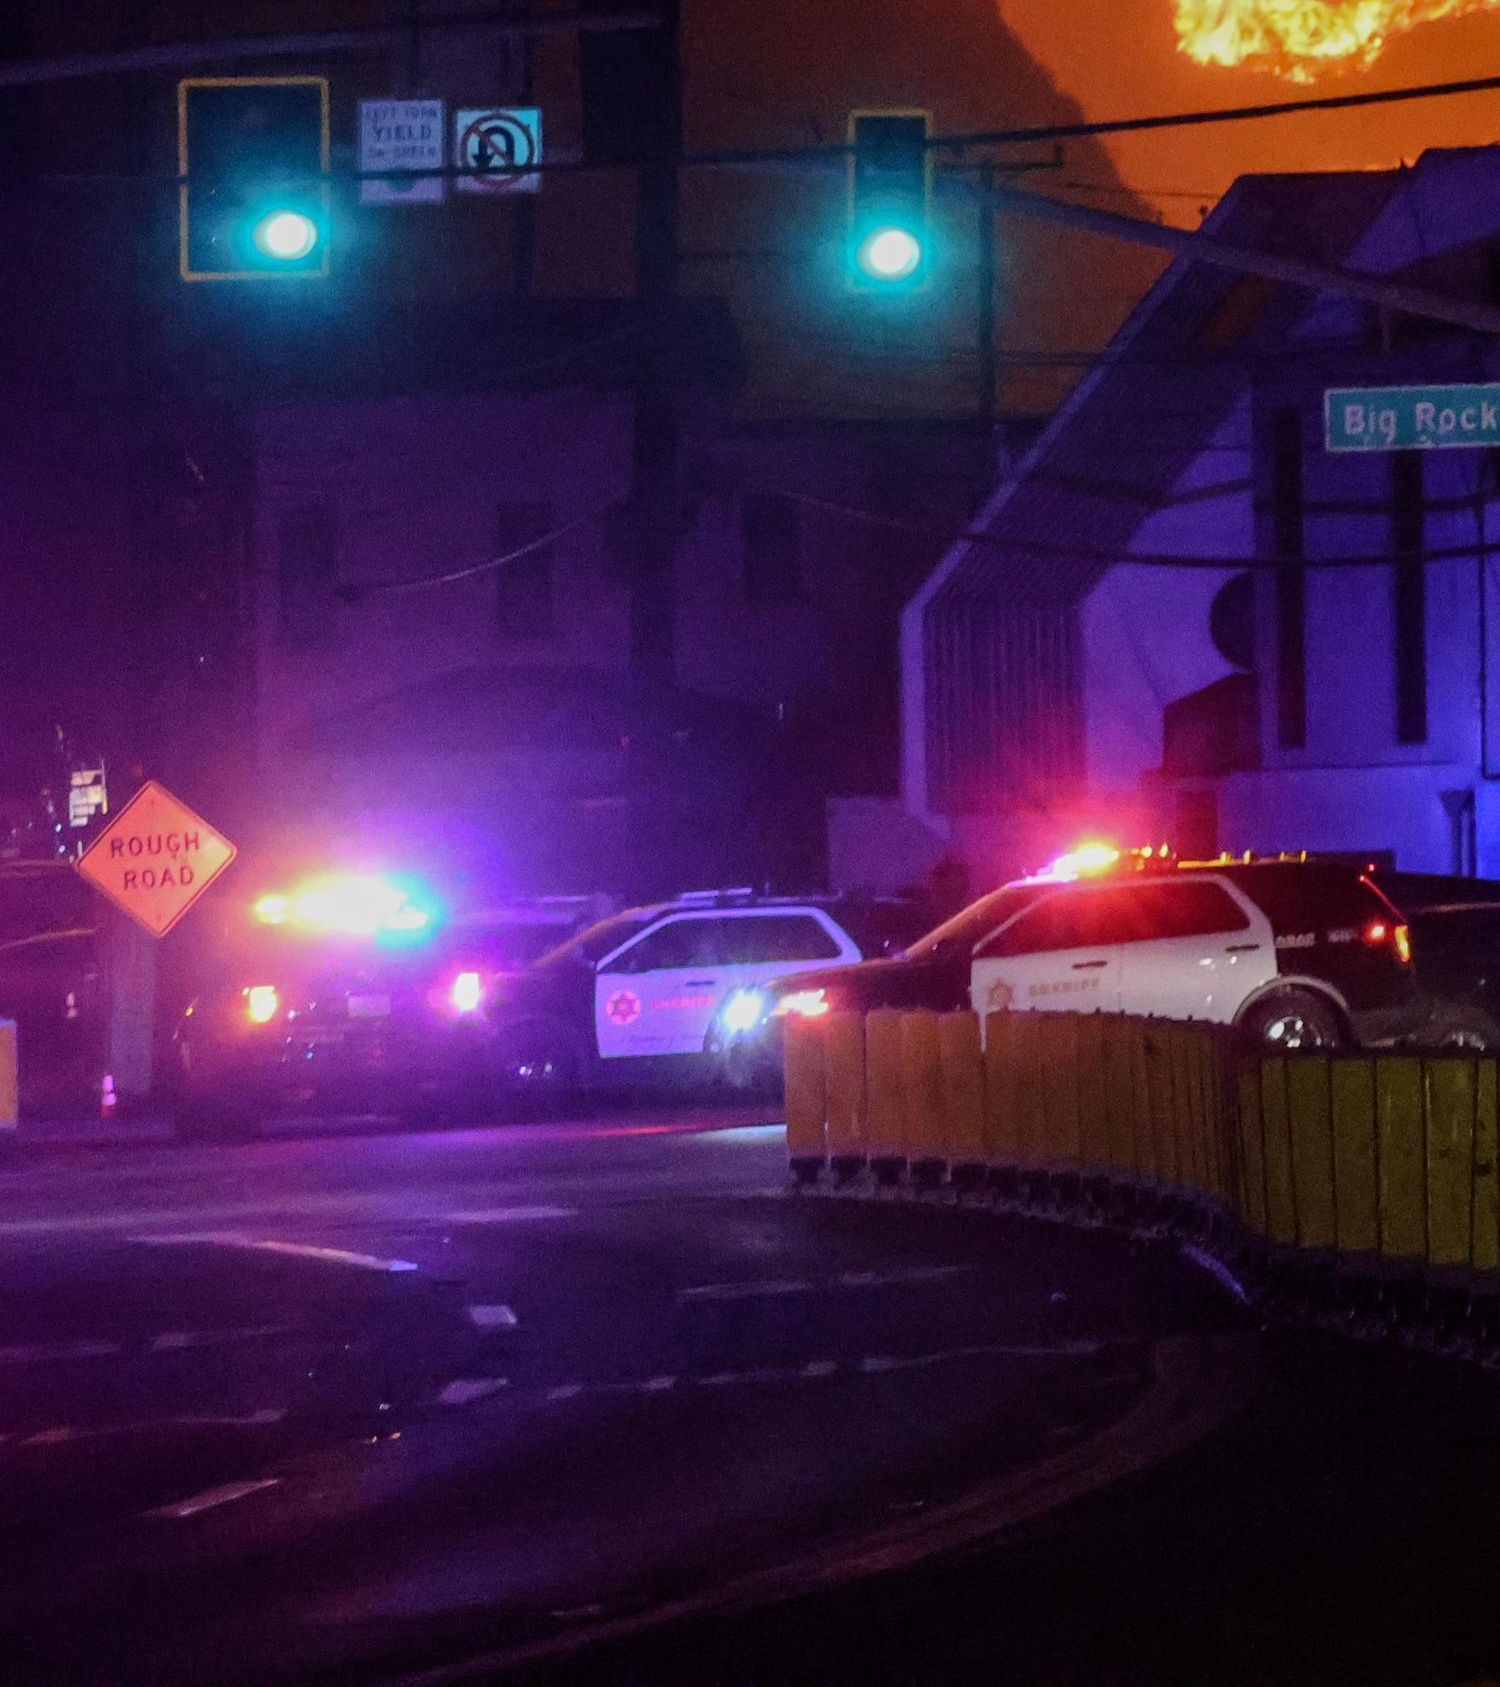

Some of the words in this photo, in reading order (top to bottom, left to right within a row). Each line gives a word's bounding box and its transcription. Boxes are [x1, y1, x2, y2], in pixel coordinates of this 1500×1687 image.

[372, 124, 432, 141] YIELD
[1344, 404, 1398, 445] Big
[1414, 400, 1498, 433] Rock
[110, 832, 199, 858] ROUGH
[123, 866, 194, 890] ROAD
